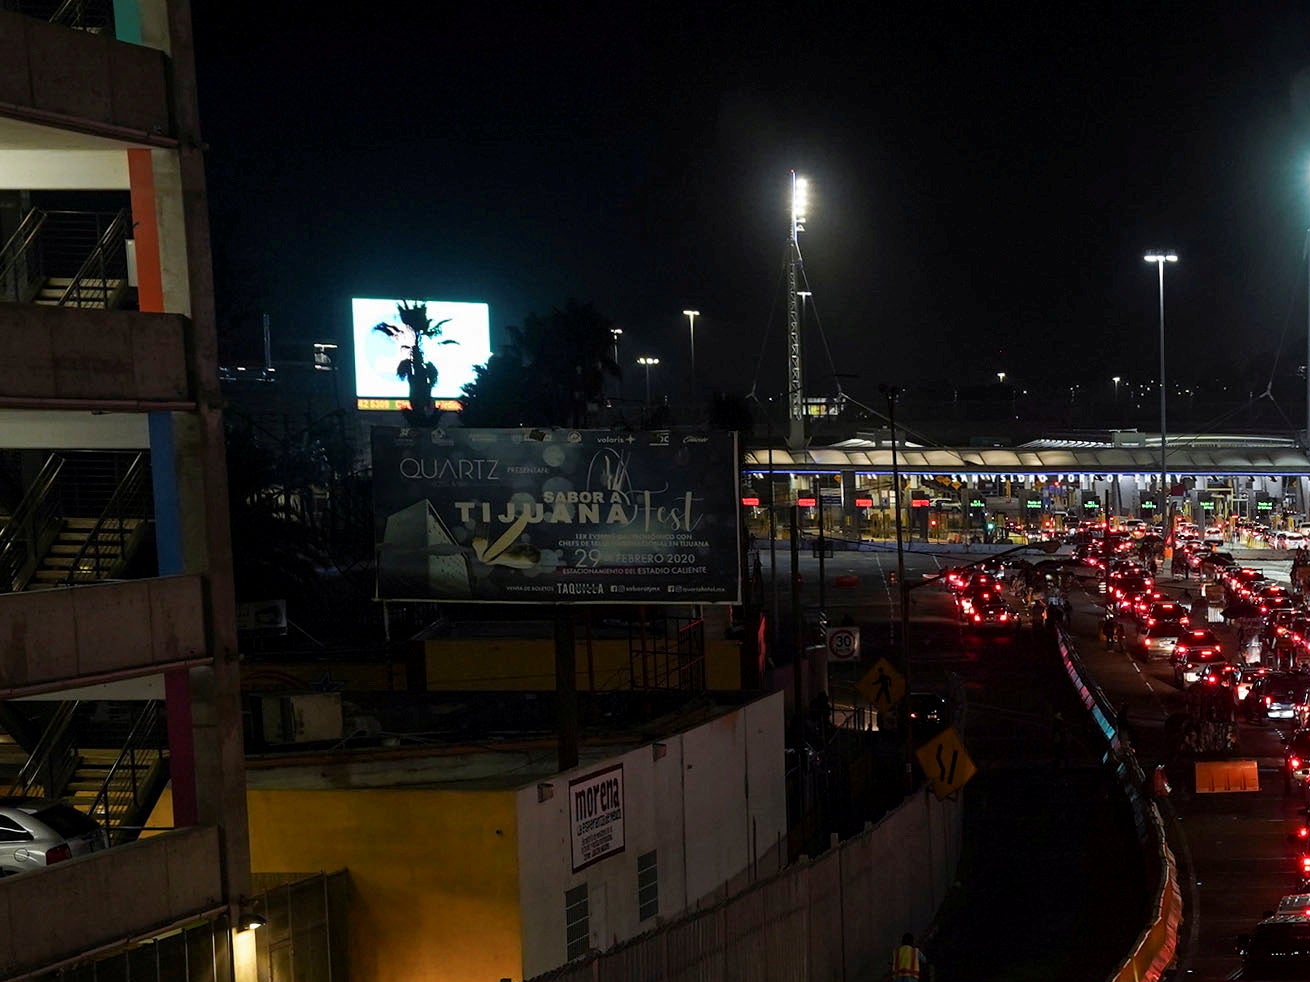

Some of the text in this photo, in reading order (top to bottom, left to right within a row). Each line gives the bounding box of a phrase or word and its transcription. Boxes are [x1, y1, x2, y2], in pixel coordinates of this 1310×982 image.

[399, 457, 500, 480] QUARTZ
[951, 474, 1182, 483] SAN YSIDRO PORT OF ENTRY
[544, 491, 623, 504] SABOR A
[454, 502, 629, 524] TIJUANA
[628, 481, 704, 532] Fest
[574, 548, 602, 568] 29
[616, 554, 664, 564] FEBRERO
[667, 554, 696, 564] 2020
[671, 566, 708, 574] CALIENTE
[557, 583, 604, 594] TAQUILLA
[836, 636, 852, 648] 30
[574, 777, 620, 822] morena
